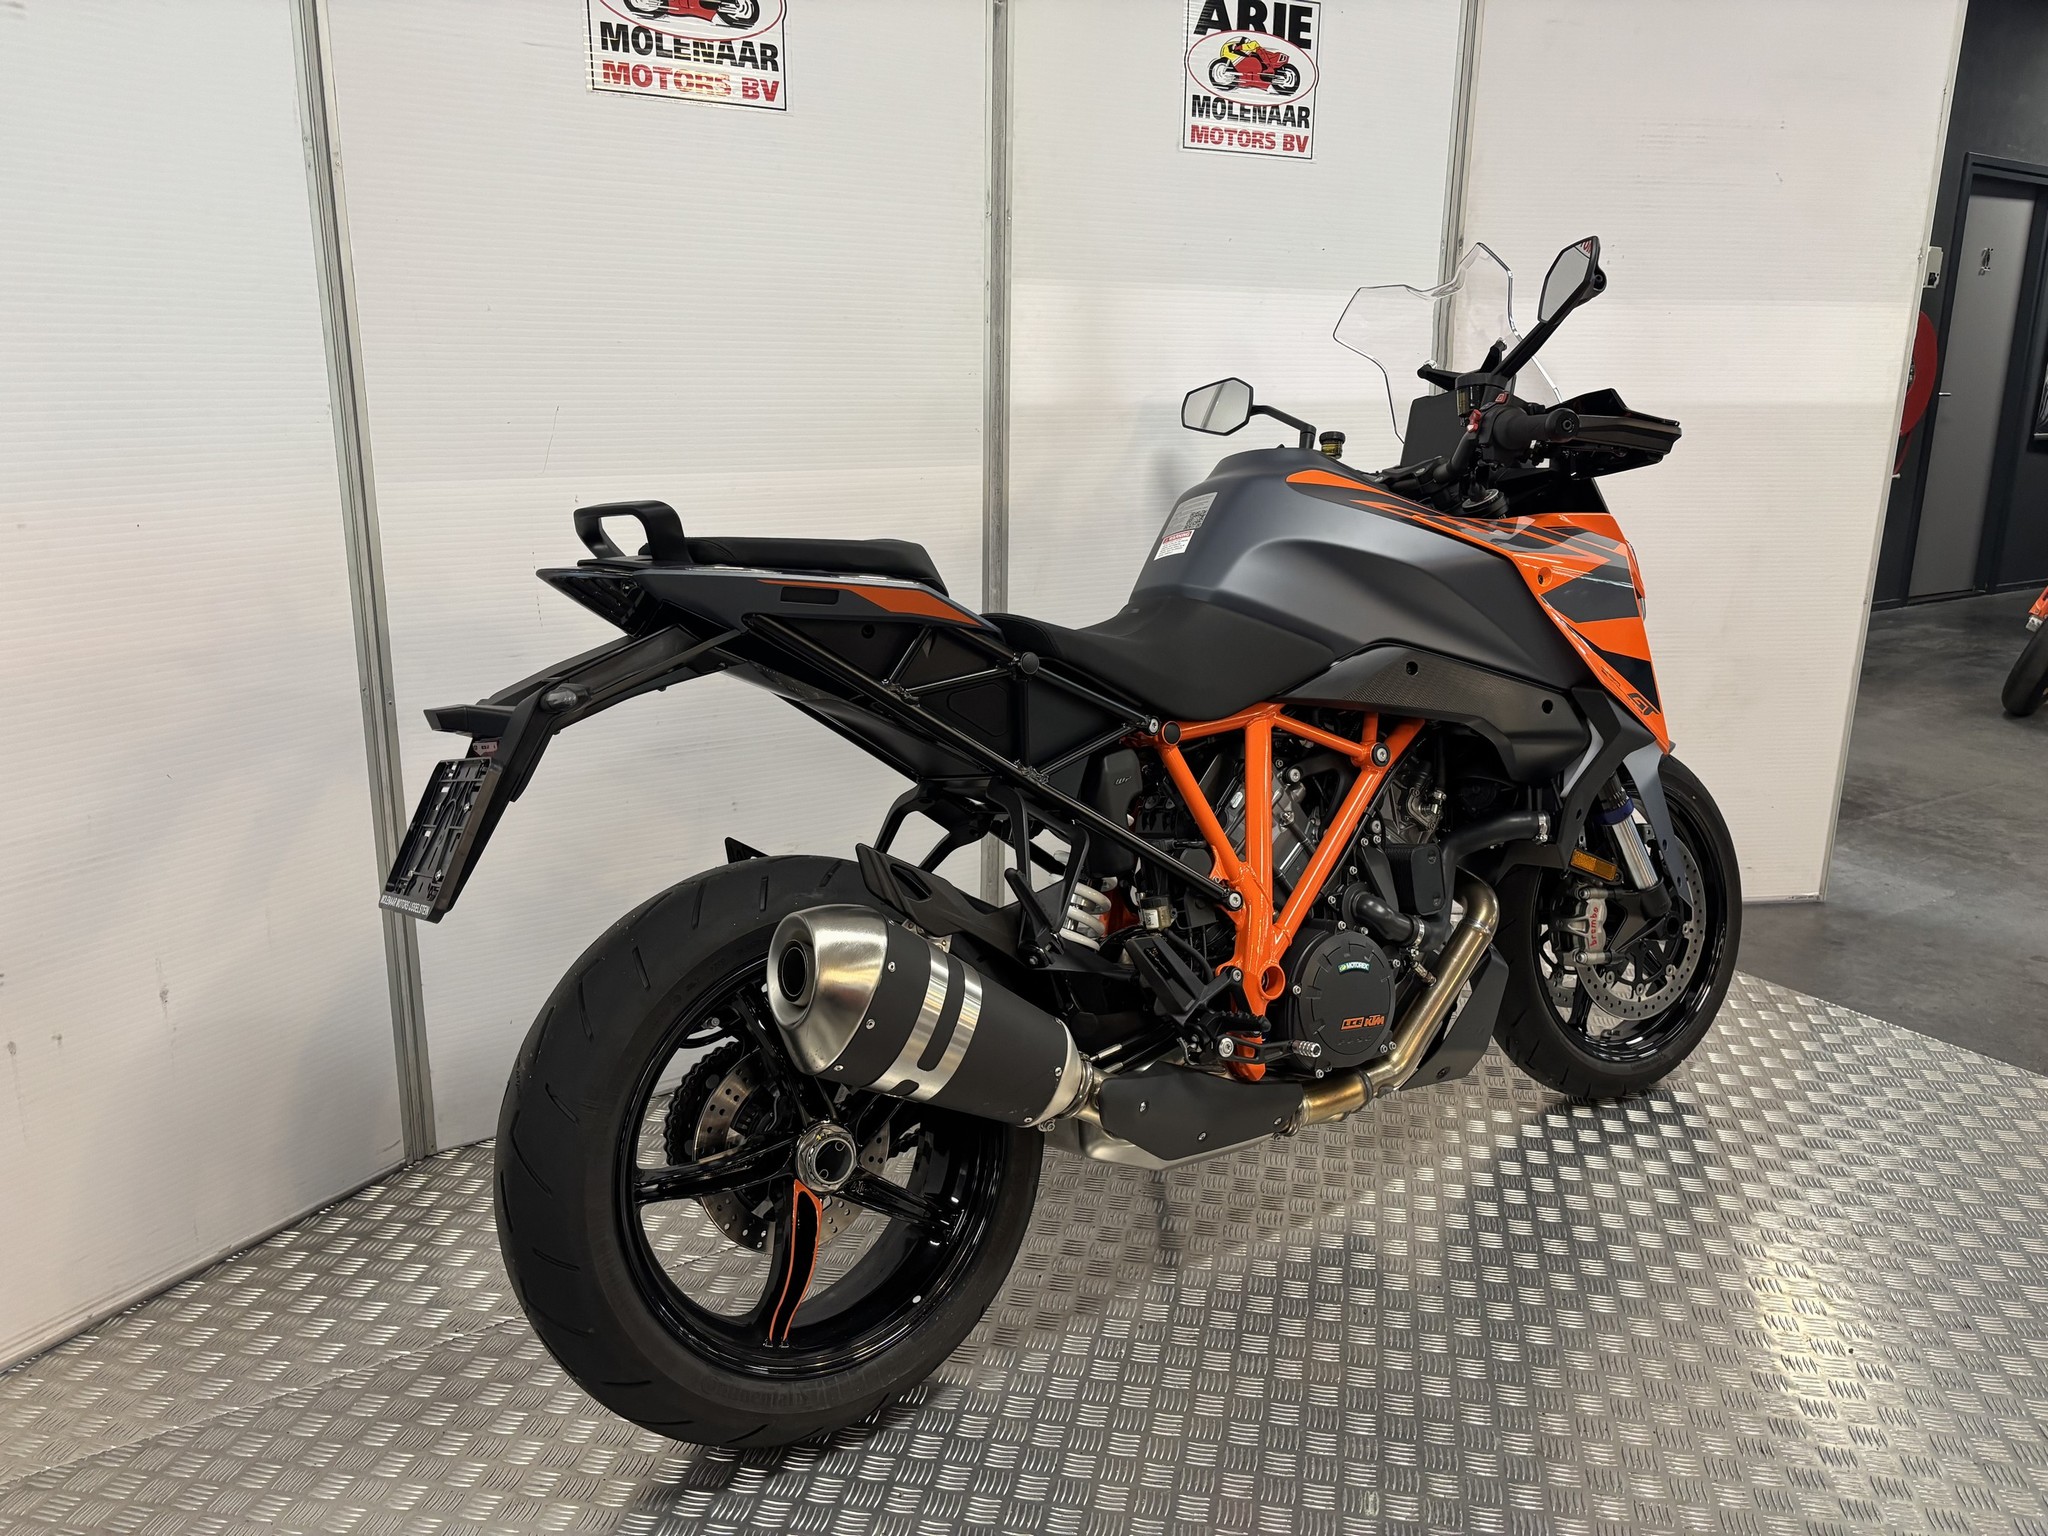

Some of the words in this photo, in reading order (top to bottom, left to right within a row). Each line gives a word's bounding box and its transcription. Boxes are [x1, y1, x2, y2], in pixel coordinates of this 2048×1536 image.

[1194, 0, 1313, 49] ARIE
[600, 21, 780, 72] MOLENAAR
[602, 60, 732, 96] MOTORS
[741, 77, 780, 102] BV
[1192, 94, 1311, 129] MOLENAAR
[1190, 125, 1276, 150] MOTORS
[1282, 133, 1310, 153] BV
[1590, 907, 1599, 947] brembo
[1346, 961, 1369, 970] MOTOREX
[1364, 1015, 1384, 1026] KTM
